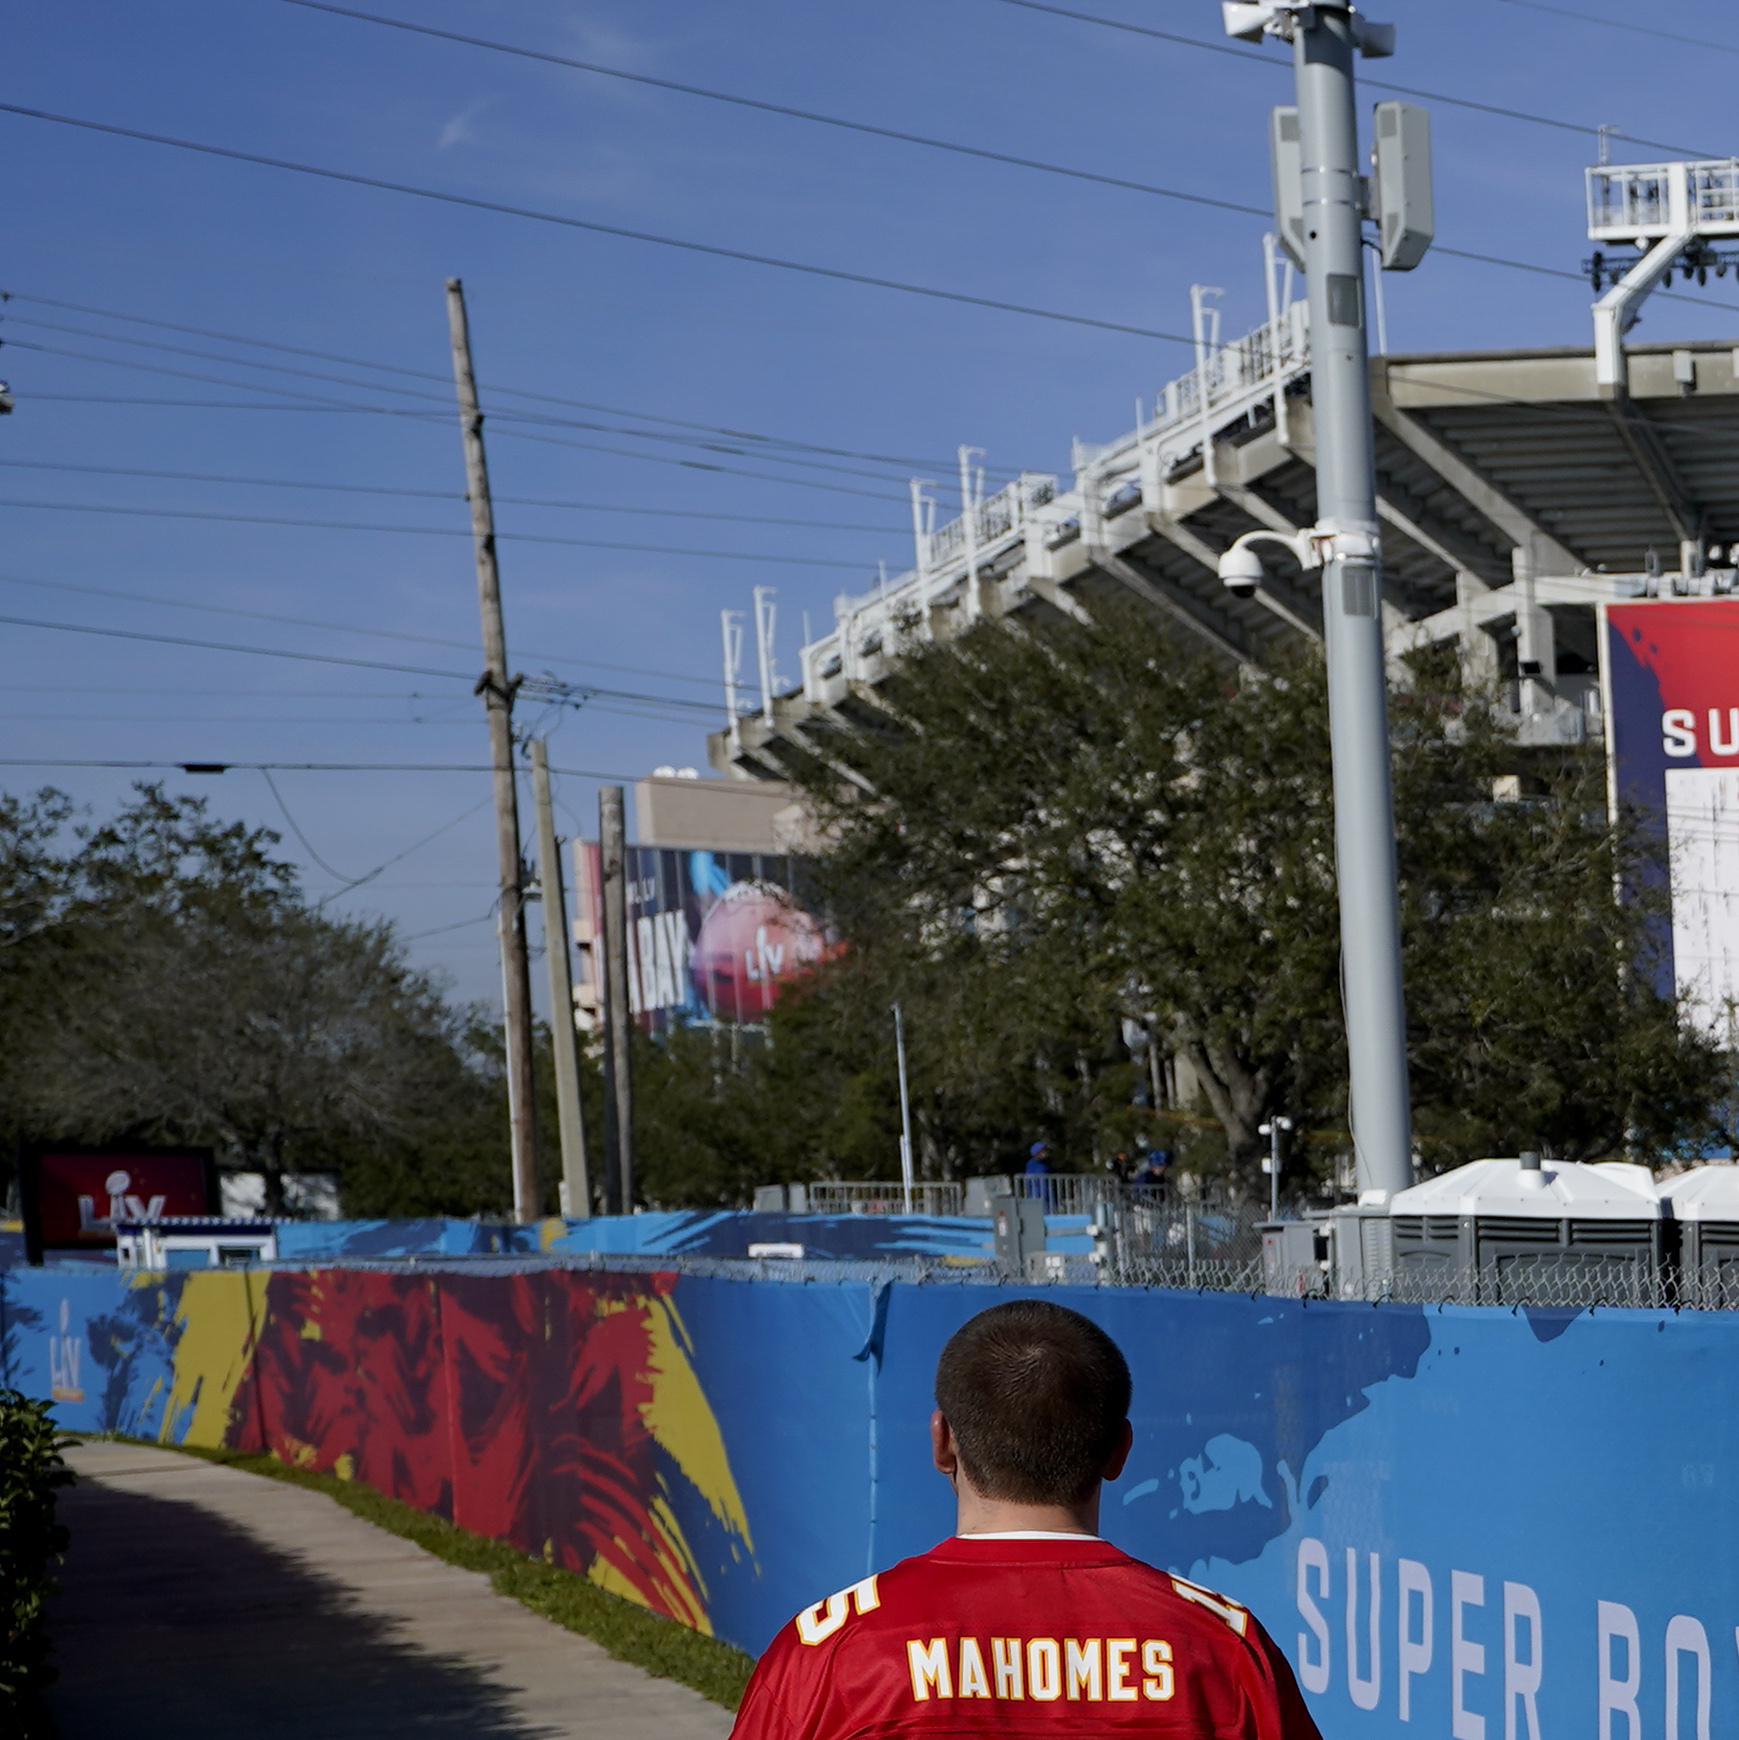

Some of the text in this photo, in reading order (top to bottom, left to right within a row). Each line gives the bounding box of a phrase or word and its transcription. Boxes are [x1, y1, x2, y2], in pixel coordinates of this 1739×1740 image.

[77, 1169, 167, 1233] LIV
[795, 1573, 881, 1646] 5
[906, 1636, 1177, 1702] MAHOMES
